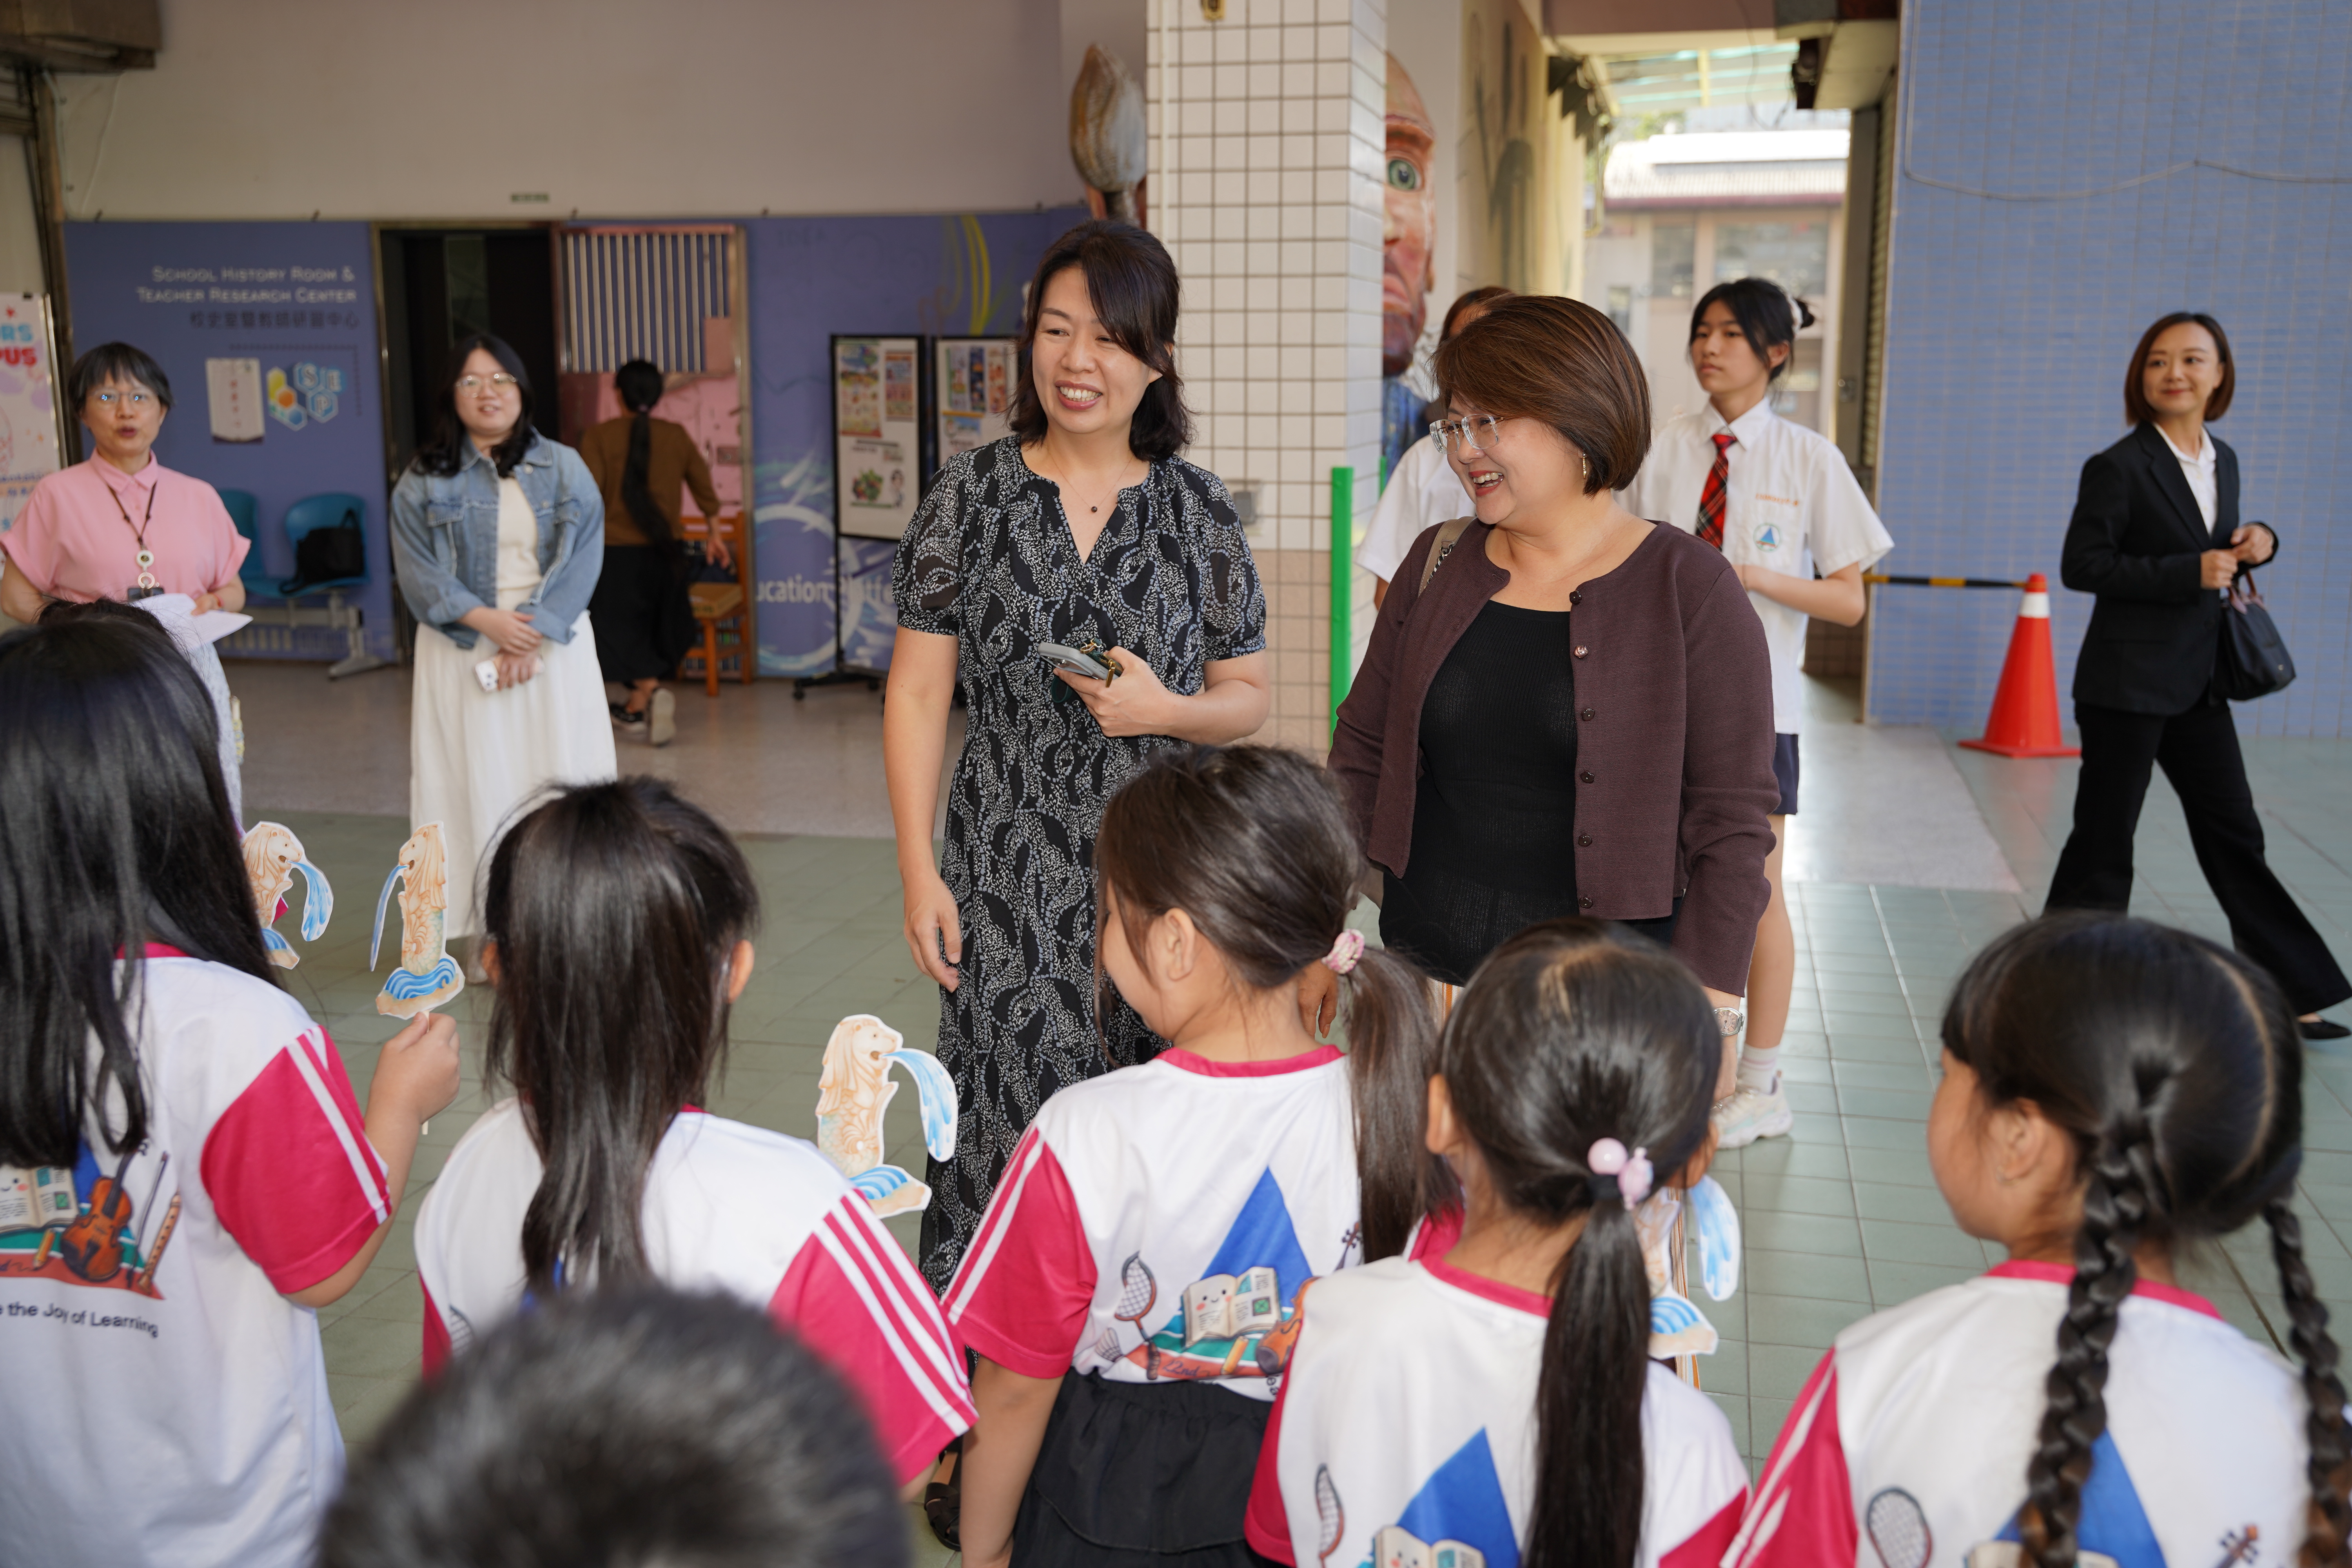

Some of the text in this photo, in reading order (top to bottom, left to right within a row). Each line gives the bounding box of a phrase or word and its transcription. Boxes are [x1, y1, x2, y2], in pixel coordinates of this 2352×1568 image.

[152, 266, 355, 282] SCHOOL HISTORY ROOM &
[136, 287, 357, 303] TEACHER RESEARCH CENTER
[8, 1301, 38, 1316] the
[43, 1303, 68, 1323] Joy
[71, 1311, 86, 1325] of
[90, 1312, 158, 1339] Learning
